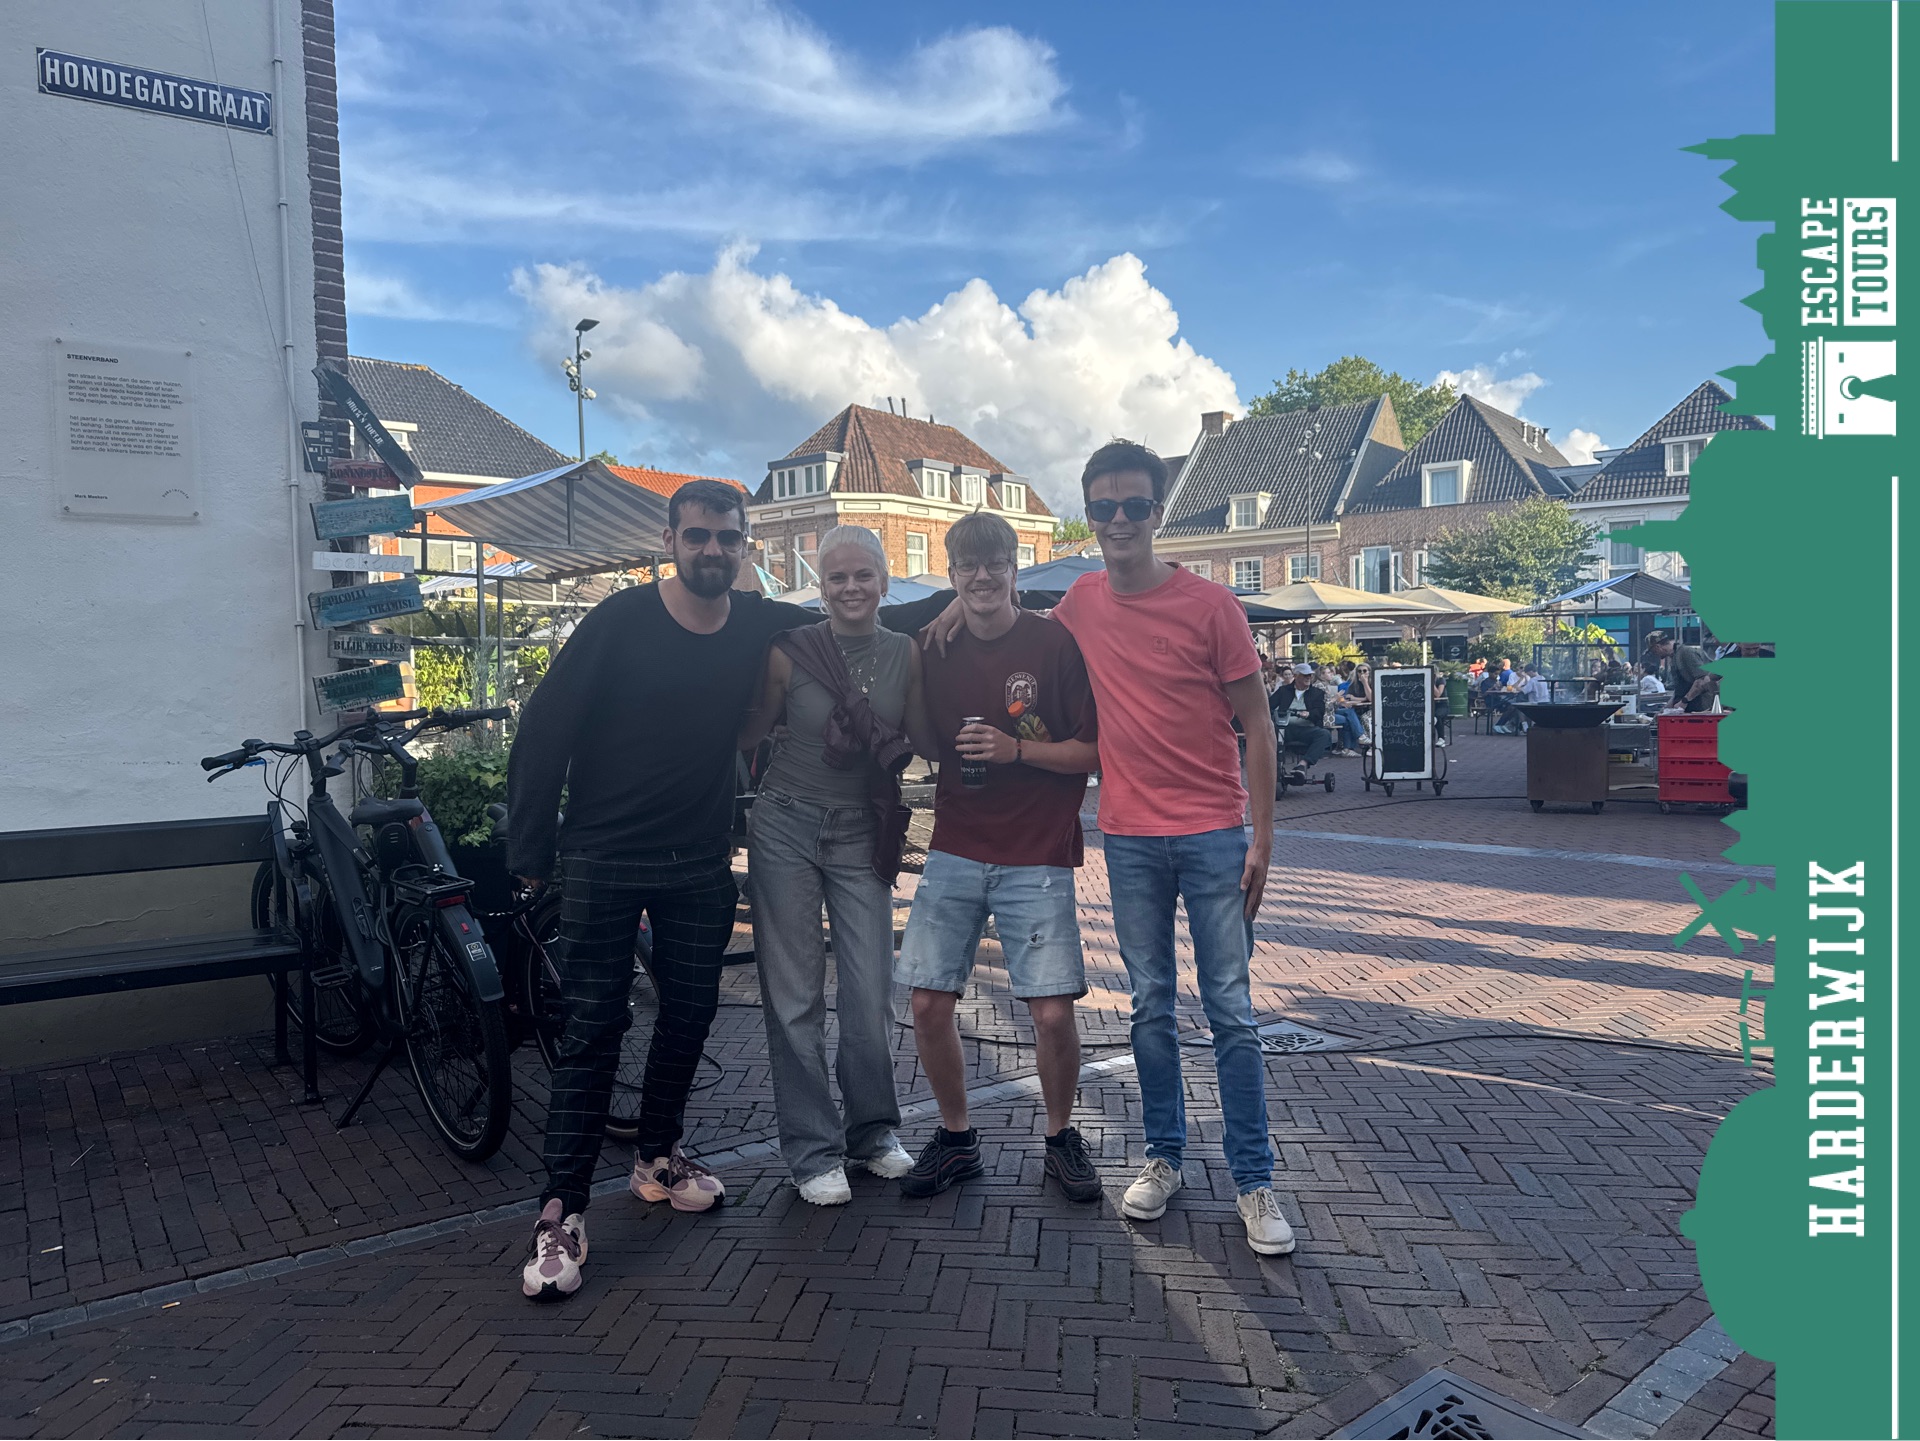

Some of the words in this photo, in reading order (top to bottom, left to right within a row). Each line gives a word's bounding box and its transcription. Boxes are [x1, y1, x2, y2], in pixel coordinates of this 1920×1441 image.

[45, 57, 265, 124] HONDEGATSTRAAT
[67, 354, 118, 364] STEENVERBAND
[365, 642, 405, 652] MEISJES
[1007, 674, 1035, 687] BIENVENUE
